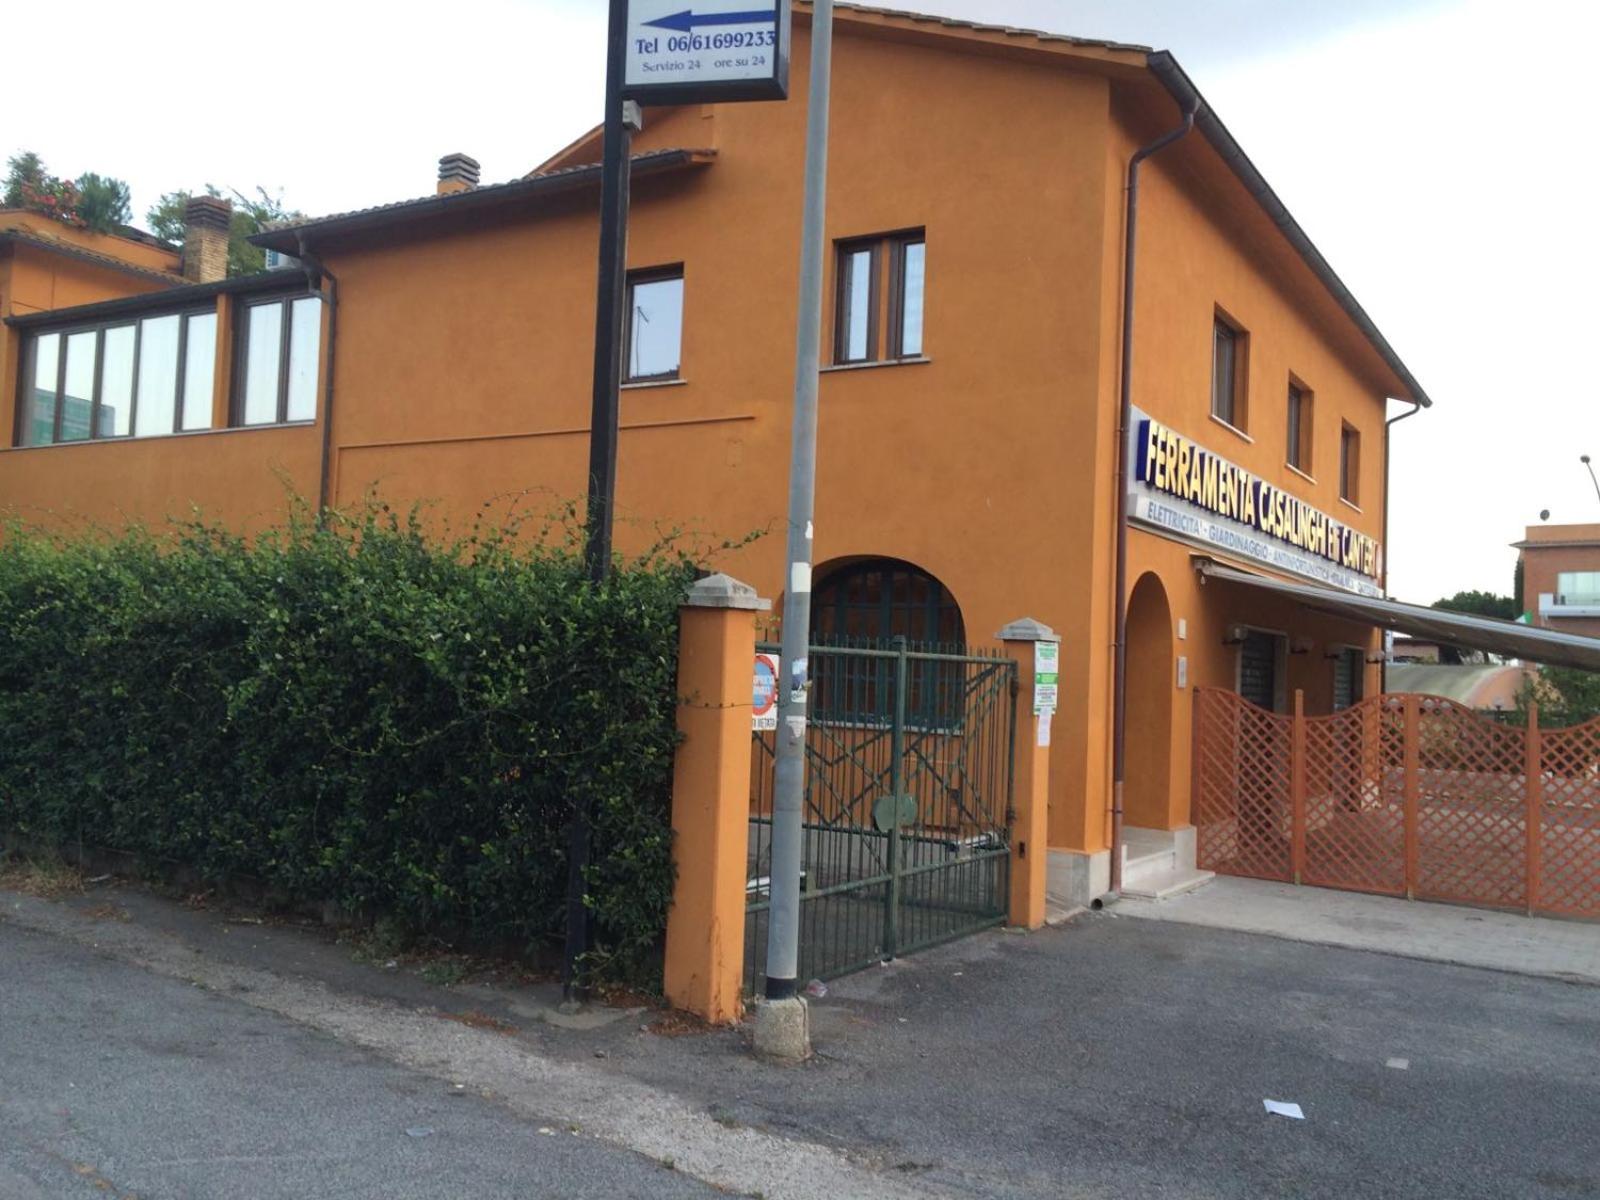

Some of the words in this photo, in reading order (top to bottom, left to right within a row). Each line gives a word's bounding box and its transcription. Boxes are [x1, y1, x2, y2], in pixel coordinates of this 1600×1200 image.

[636, 38, 658, 54] Tel
[667, 30, 776, 53] 06/61699233
[642, 59, 684, 72] Servizio
[688, 58, 701, 70] 24
[714, 57, 732, 68] ore
[735, 56, 749, 67] su
[752, 54, 766, 66] 24
[1146, 420, 1256, 526] FERRAMENTA
